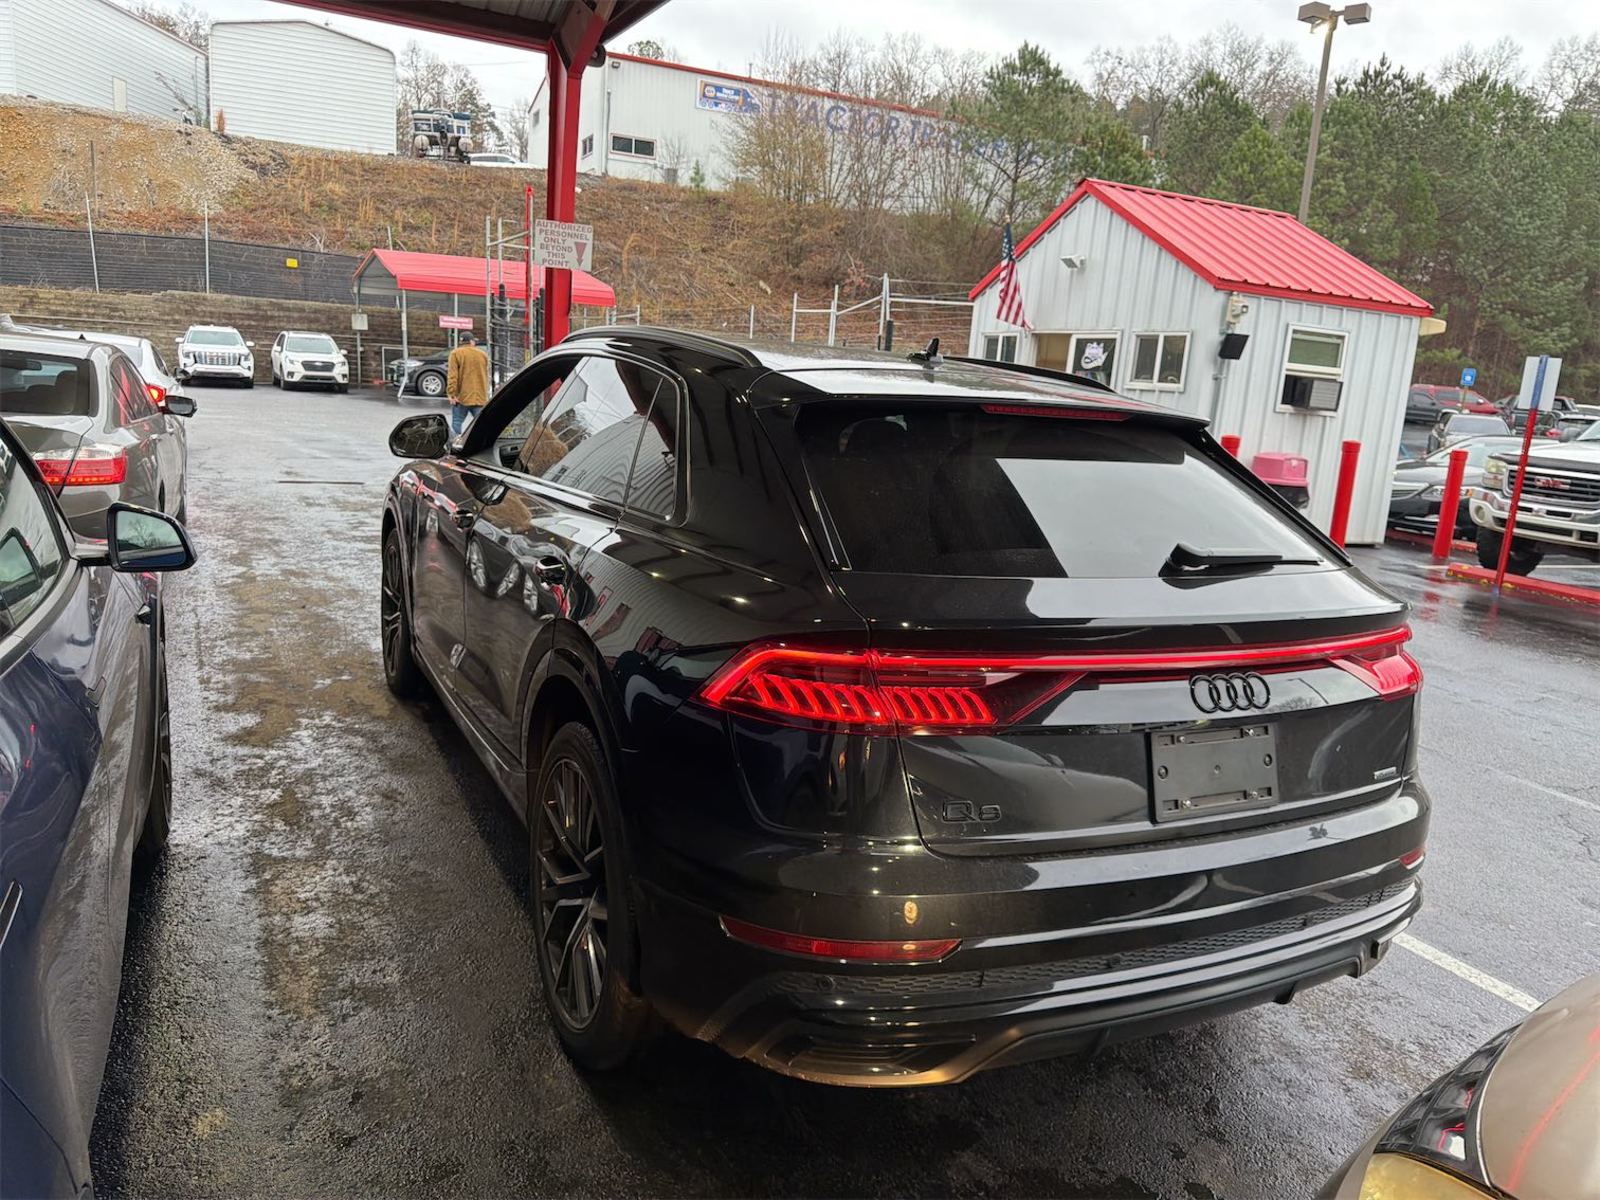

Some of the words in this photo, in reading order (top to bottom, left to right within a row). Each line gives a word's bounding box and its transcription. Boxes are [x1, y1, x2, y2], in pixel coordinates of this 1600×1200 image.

[536, 220, 593, 233] AUTHORIZED
[539, 228, 590, 241] PERSONNEL
[543, 236, 567, 245] ONLY
[540, 243, 573, 253] BEYOND
[547, 251, 566, 259] THIS
[542, 258, 570, 267] POINT
[941, 800, 1001, 823] Q8
